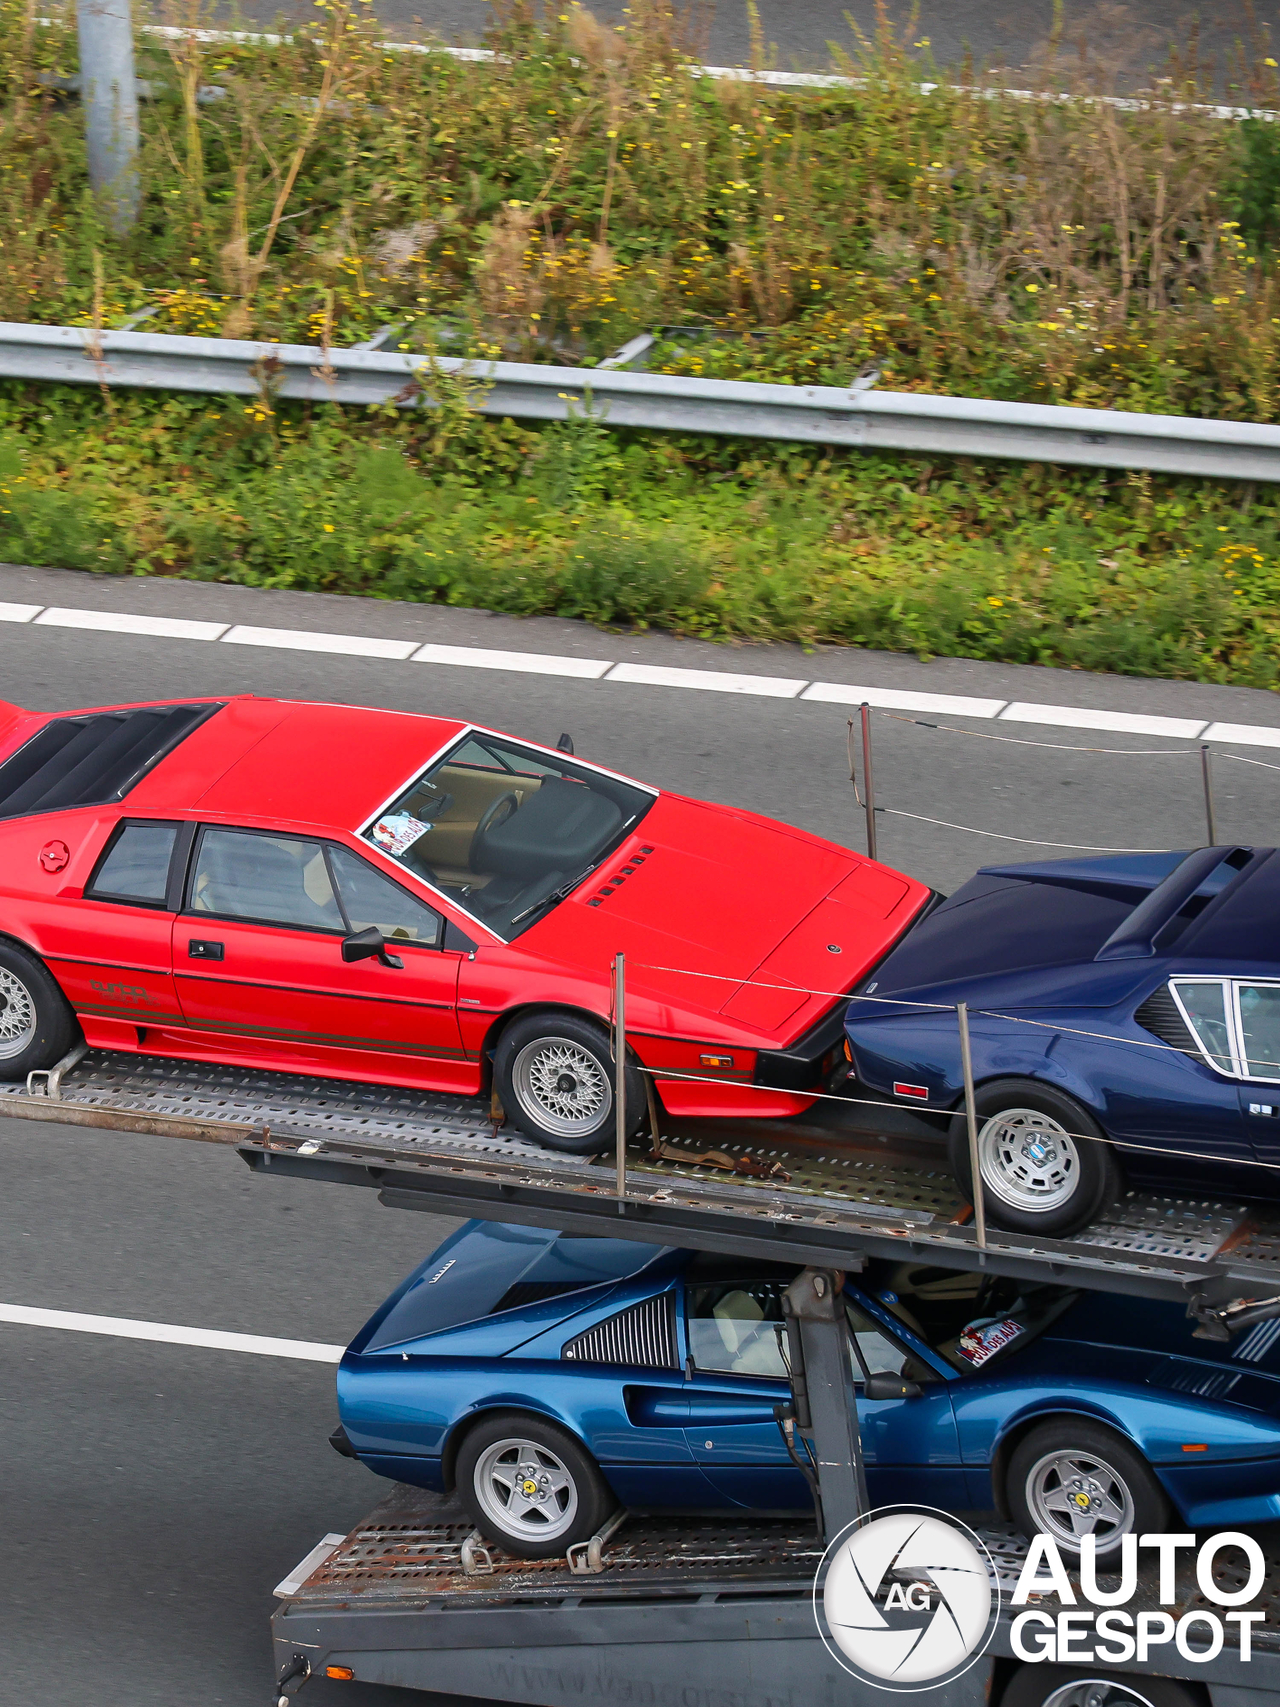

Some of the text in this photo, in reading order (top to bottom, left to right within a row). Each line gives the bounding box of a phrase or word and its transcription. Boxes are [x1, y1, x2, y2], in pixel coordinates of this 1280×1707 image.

[89, 979, 148, 998] turbo
[986, 1334, 1006, 1349] DES
[999, 1320, 1023, 1340] ALPS
